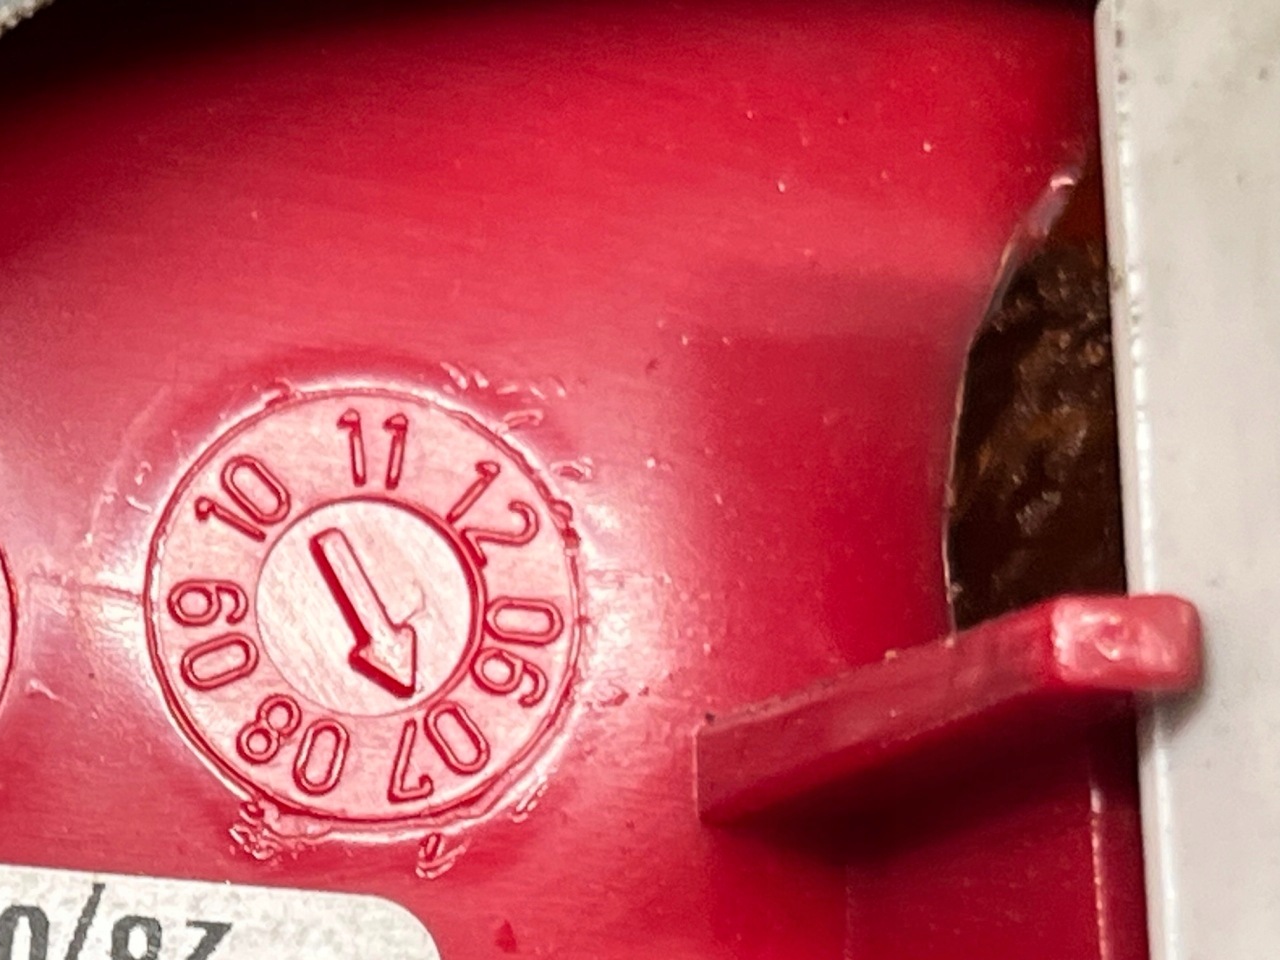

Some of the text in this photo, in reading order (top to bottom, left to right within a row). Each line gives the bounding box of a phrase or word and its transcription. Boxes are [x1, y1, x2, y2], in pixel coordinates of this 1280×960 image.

[195, 455, 291, 542] 10
[337, 408, 408, 489] 11
[444, 461, 539, 568] 12
[167, 579, 259, 691] 09
[470, 596, 564, 707] 06
[236, 693, 349, 795] 08
[388, 701, 489, 804] 07
